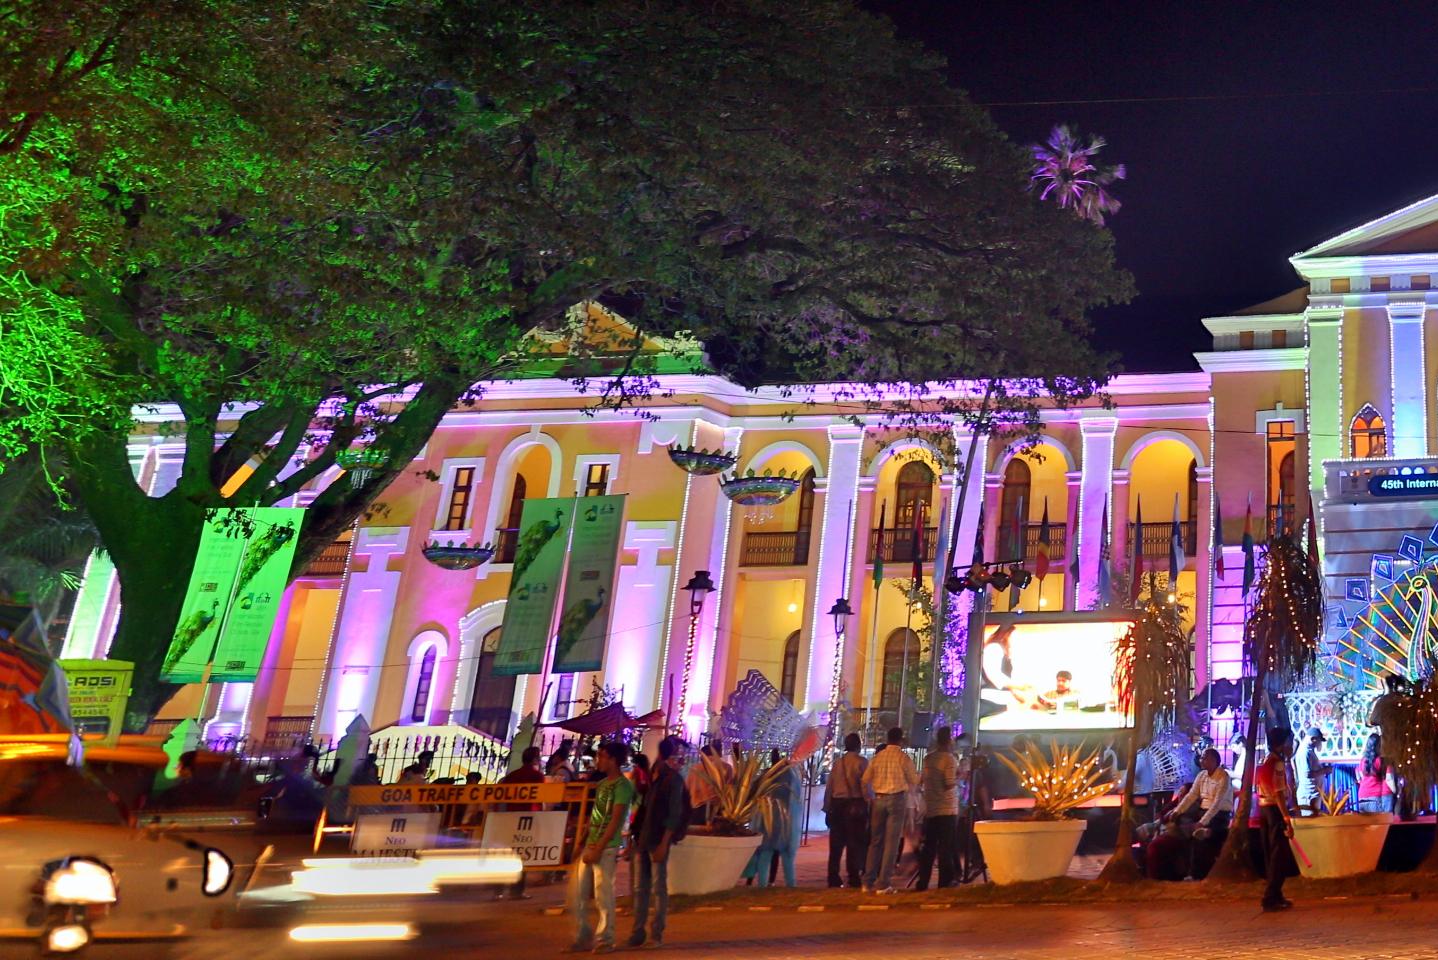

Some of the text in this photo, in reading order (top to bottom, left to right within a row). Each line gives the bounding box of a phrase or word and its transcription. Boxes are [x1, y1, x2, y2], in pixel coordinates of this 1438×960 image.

[1381, 480, 1404, 489] 45th
[74, 676, 117, 687] ADSI
[381, 785, 539, 802] GOA TRAFFC POLICE
